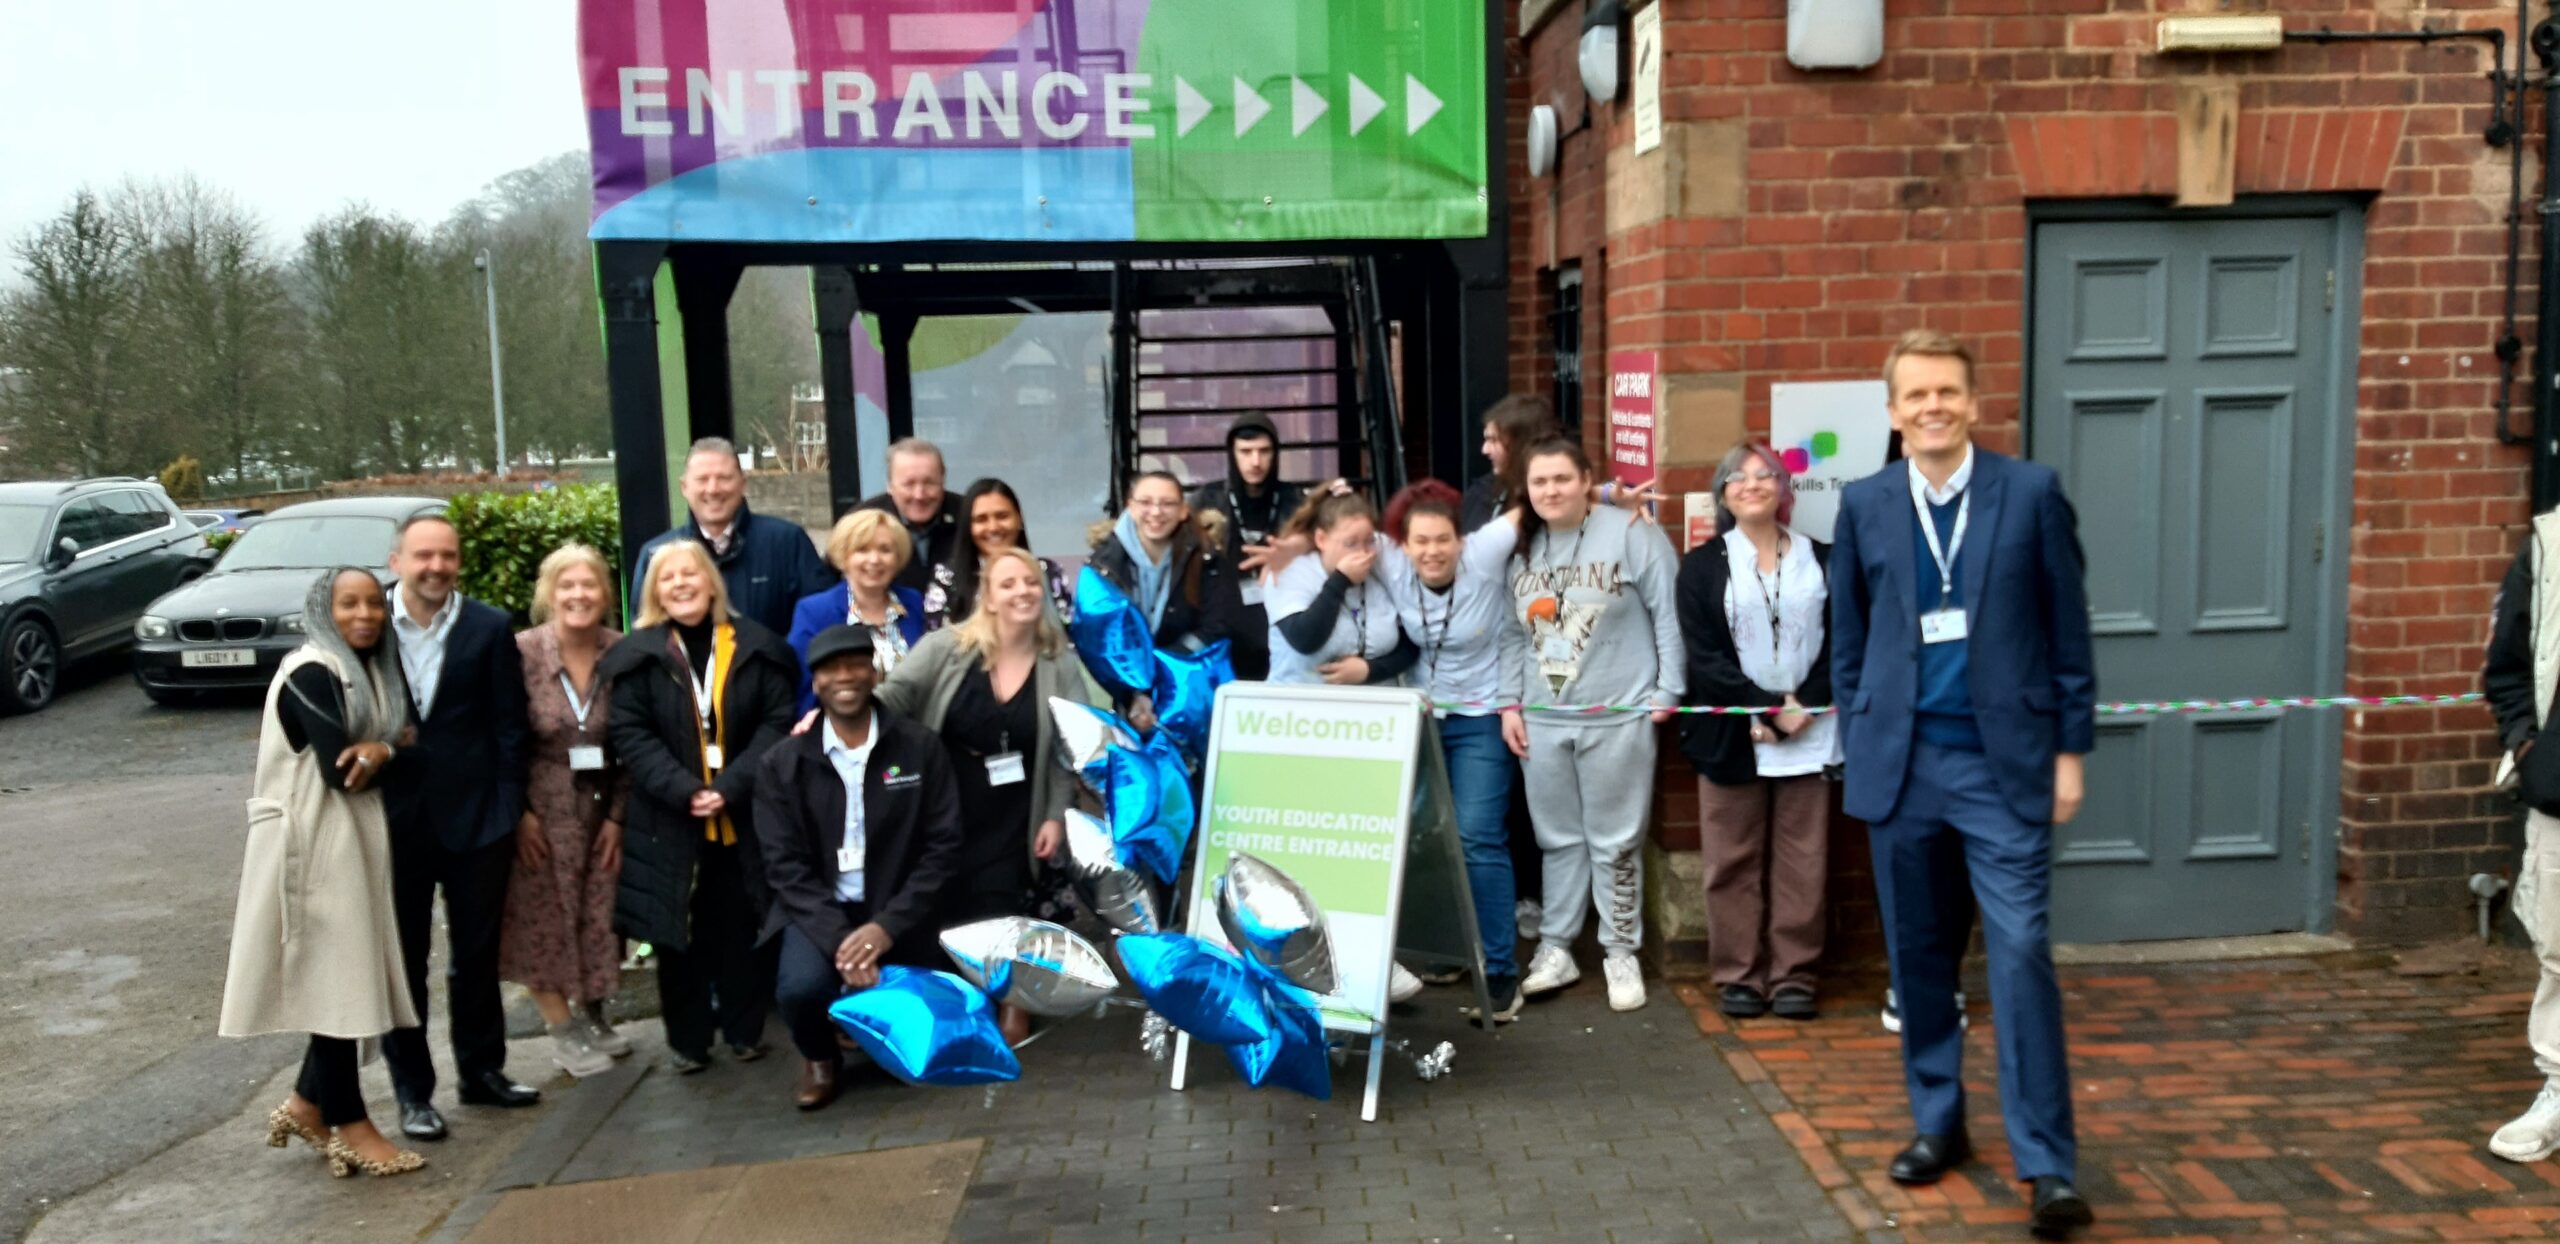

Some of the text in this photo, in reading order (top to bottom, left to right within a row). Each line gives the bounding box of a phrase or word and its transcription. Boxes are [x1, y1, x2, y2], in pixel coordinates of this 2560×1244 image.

[617, 67, 1155, 139] ENTRANCE
[1614, 372, 1651, 398] CAR PARK
[1236, 710, 1396, 742] Welcome!
[1214, 804, 1396, 834] YOUTH EDUCATION
[1210, 831, 1393, 862] CENTRE ENTRANCE
